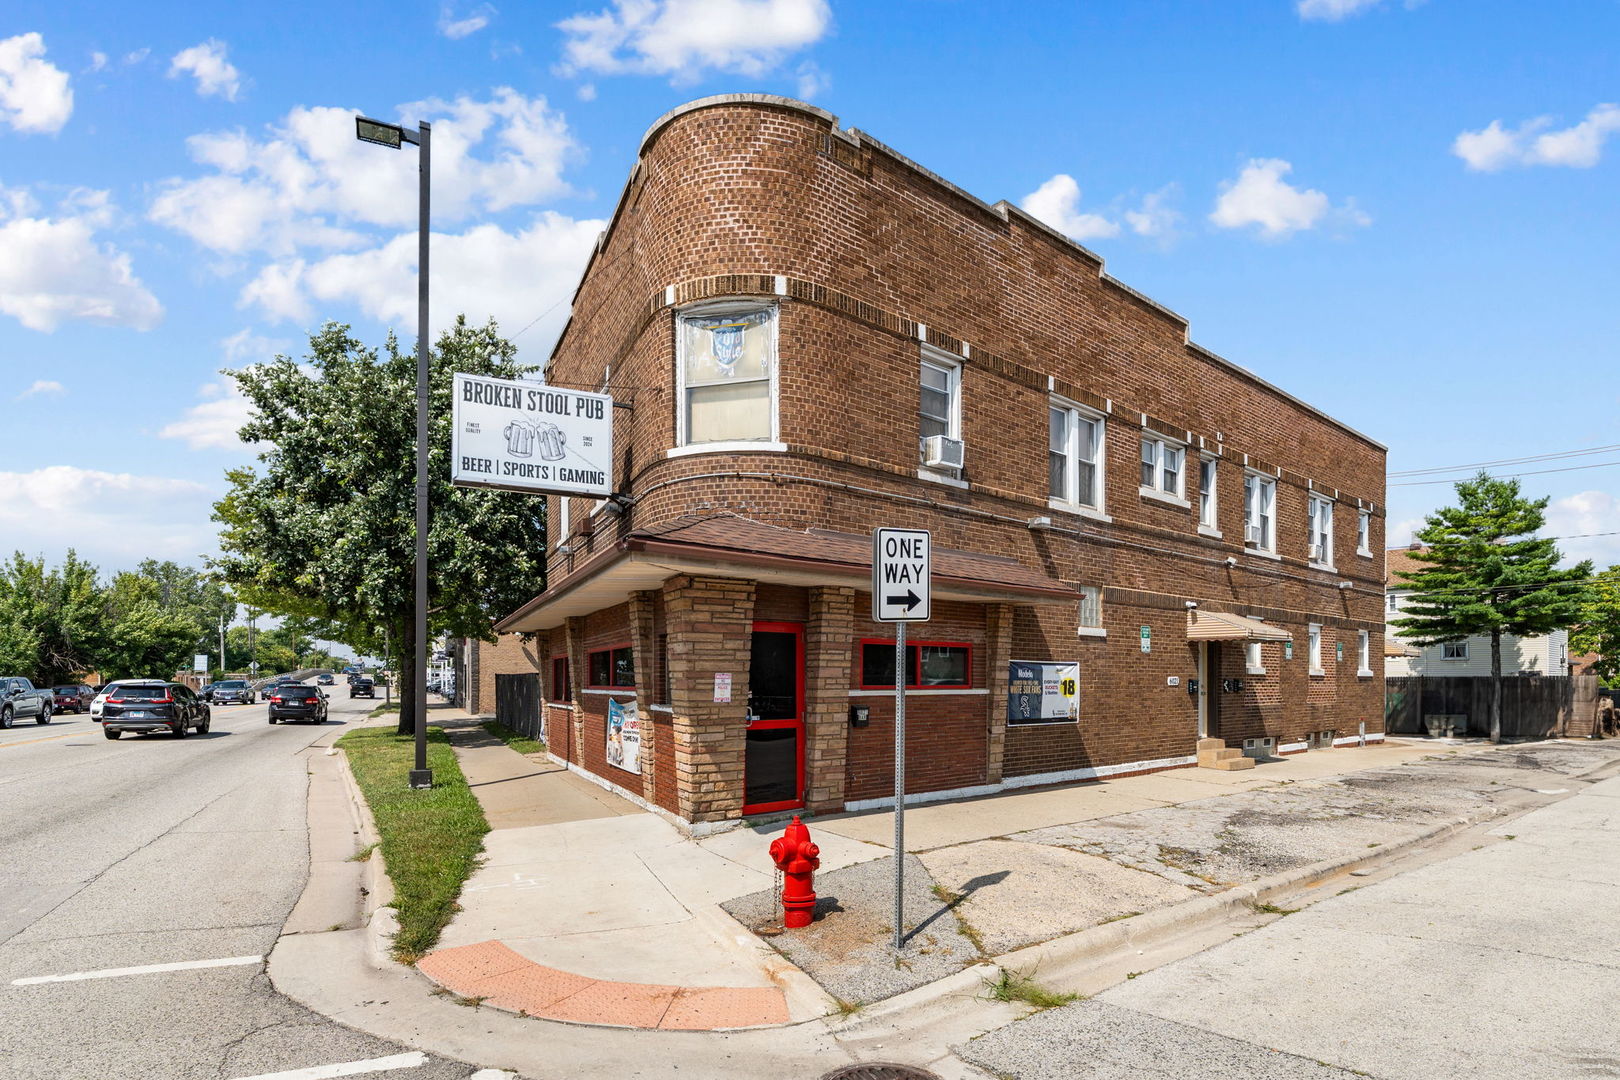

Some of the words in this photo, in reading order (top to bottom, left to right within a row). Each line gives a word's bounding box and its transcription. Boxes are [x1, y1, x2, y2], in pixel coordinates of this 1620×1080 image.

[463, 381, 522, 409] BROKEN
[527, 390, 571, 416] STOOL
[576, 397, 604, 420] PUB
[462, 457, 492, 473] BEER
[503, 461, 549, 479] SPORTS
[560, 467, 605, 485] GAMING
[886, 537, 923, 558] ONE
[884, 563, 924, 584] WAY
[1017, 668, 1034, 678] Modelo
[1023, 685, 1031, 694] SOX
[1032, 685, 1041, 695] FANS
